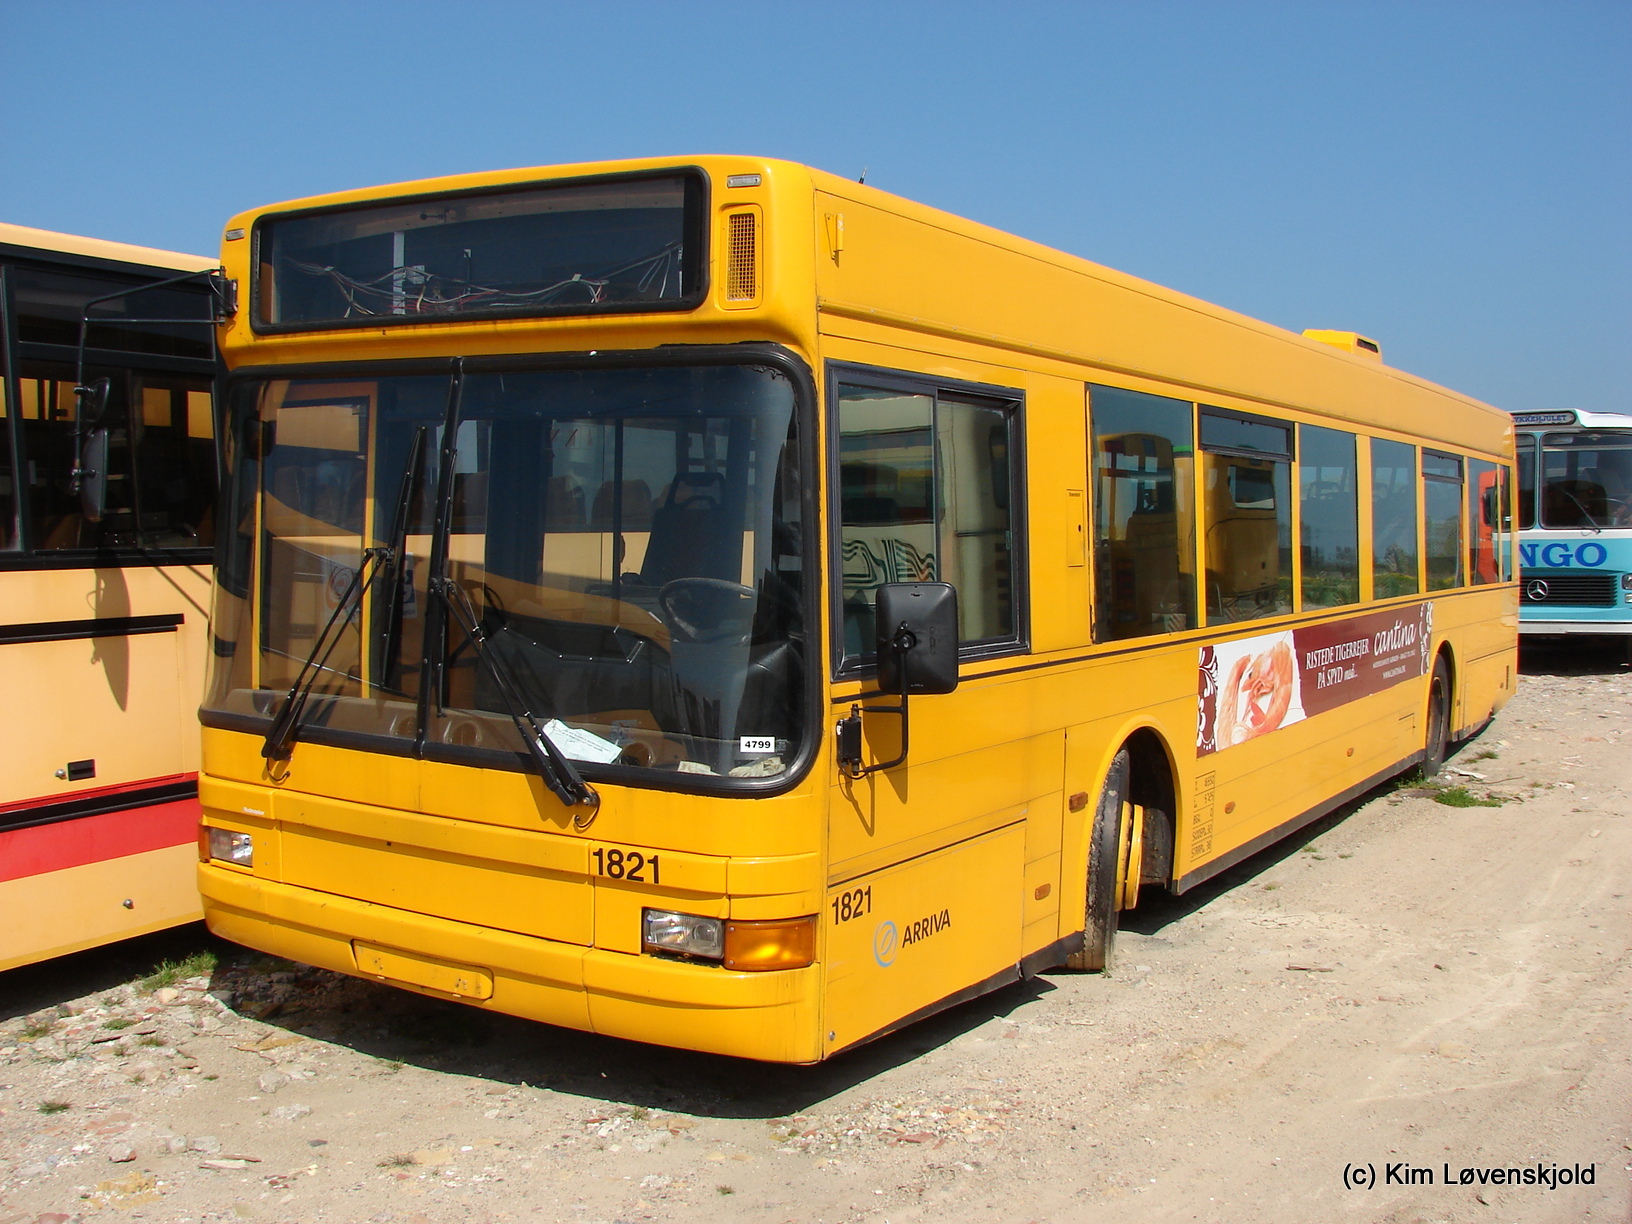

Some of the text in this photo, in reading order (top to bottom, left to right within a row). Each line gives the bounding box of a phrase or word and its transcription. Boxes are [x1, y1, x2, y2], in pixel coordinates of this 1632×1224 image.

[1306, 646, 1334, 670] RISTEDE
[1335, 638, 1369, 662] TIGERREJER
[1374, 620, 1417, 656] cantina
[1317, 666, 1326, 689] PÅ
[1327, 666, 1343, 687] SPYD
[744, 740, 771, 749] 4799
[592, 847, 660, 885] 1821
[831, 885, 872, 926] 1821
[901, 908, 951, 949] ARRIVA
